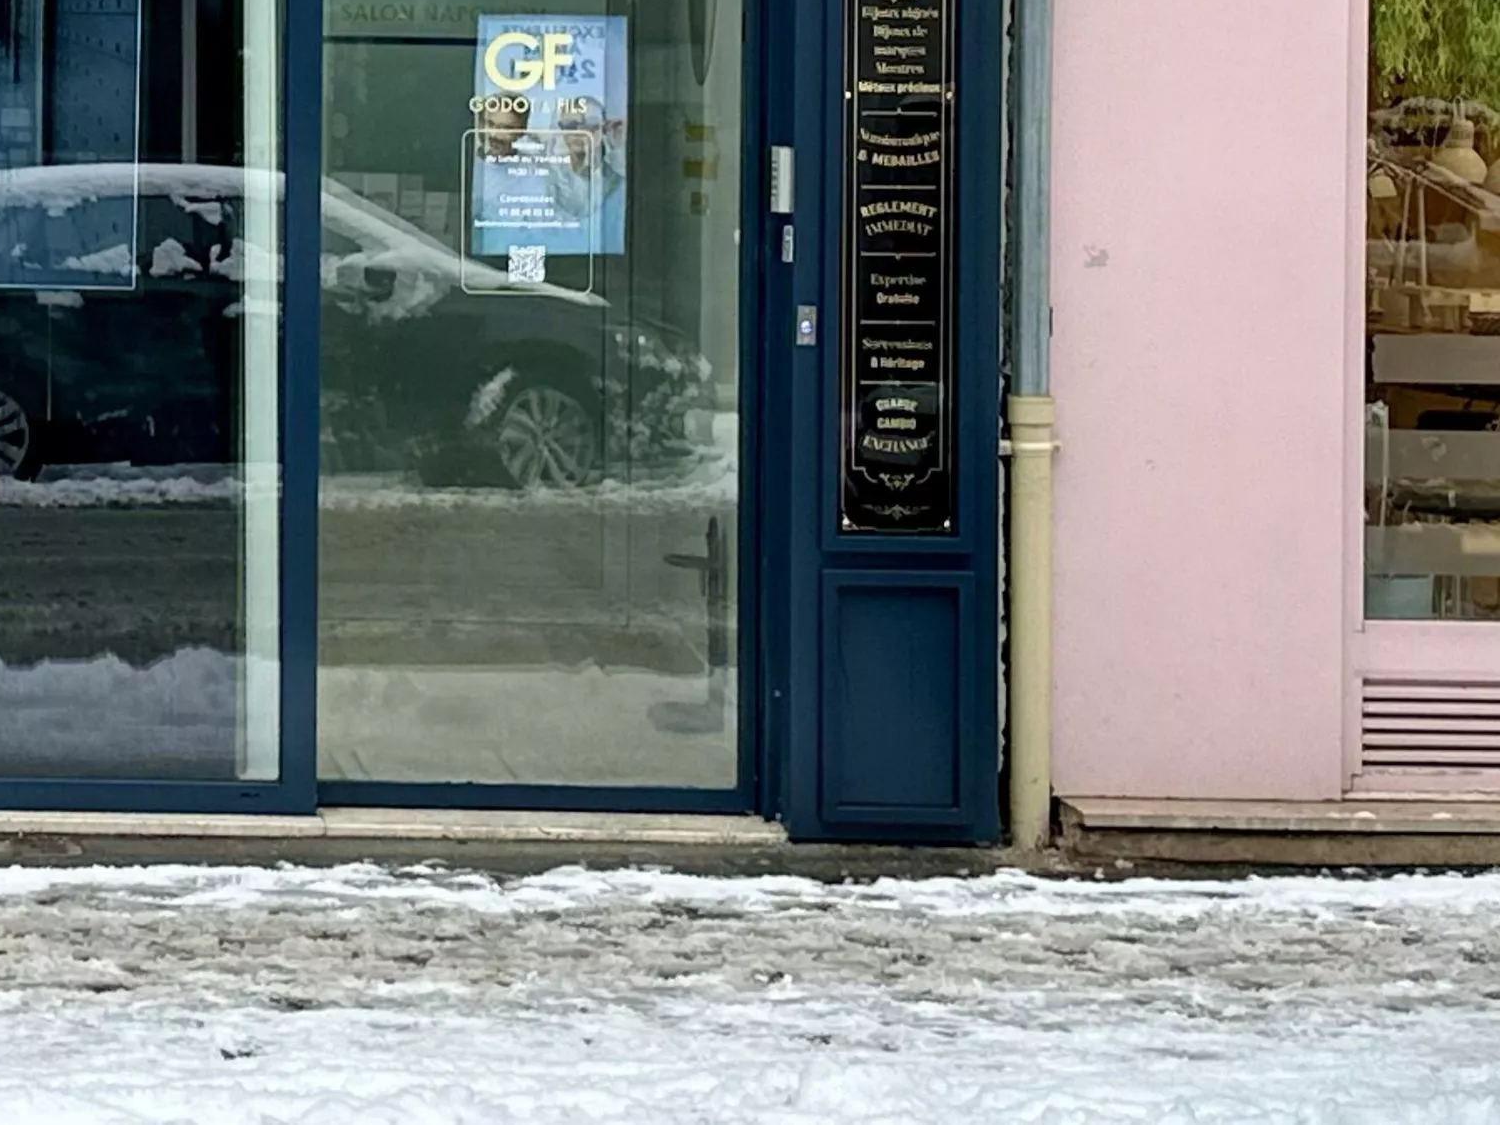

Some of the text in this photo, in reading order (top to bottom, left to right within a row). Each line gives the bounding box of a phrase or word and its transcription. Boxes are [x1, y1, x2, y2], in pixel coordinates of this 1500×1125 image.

[341, 3, 414, 22] SALON
[484, 32, 574, 92] GF
[469, 96, 536, 114] GODOT
[557, 97, 588, 114] FILS
